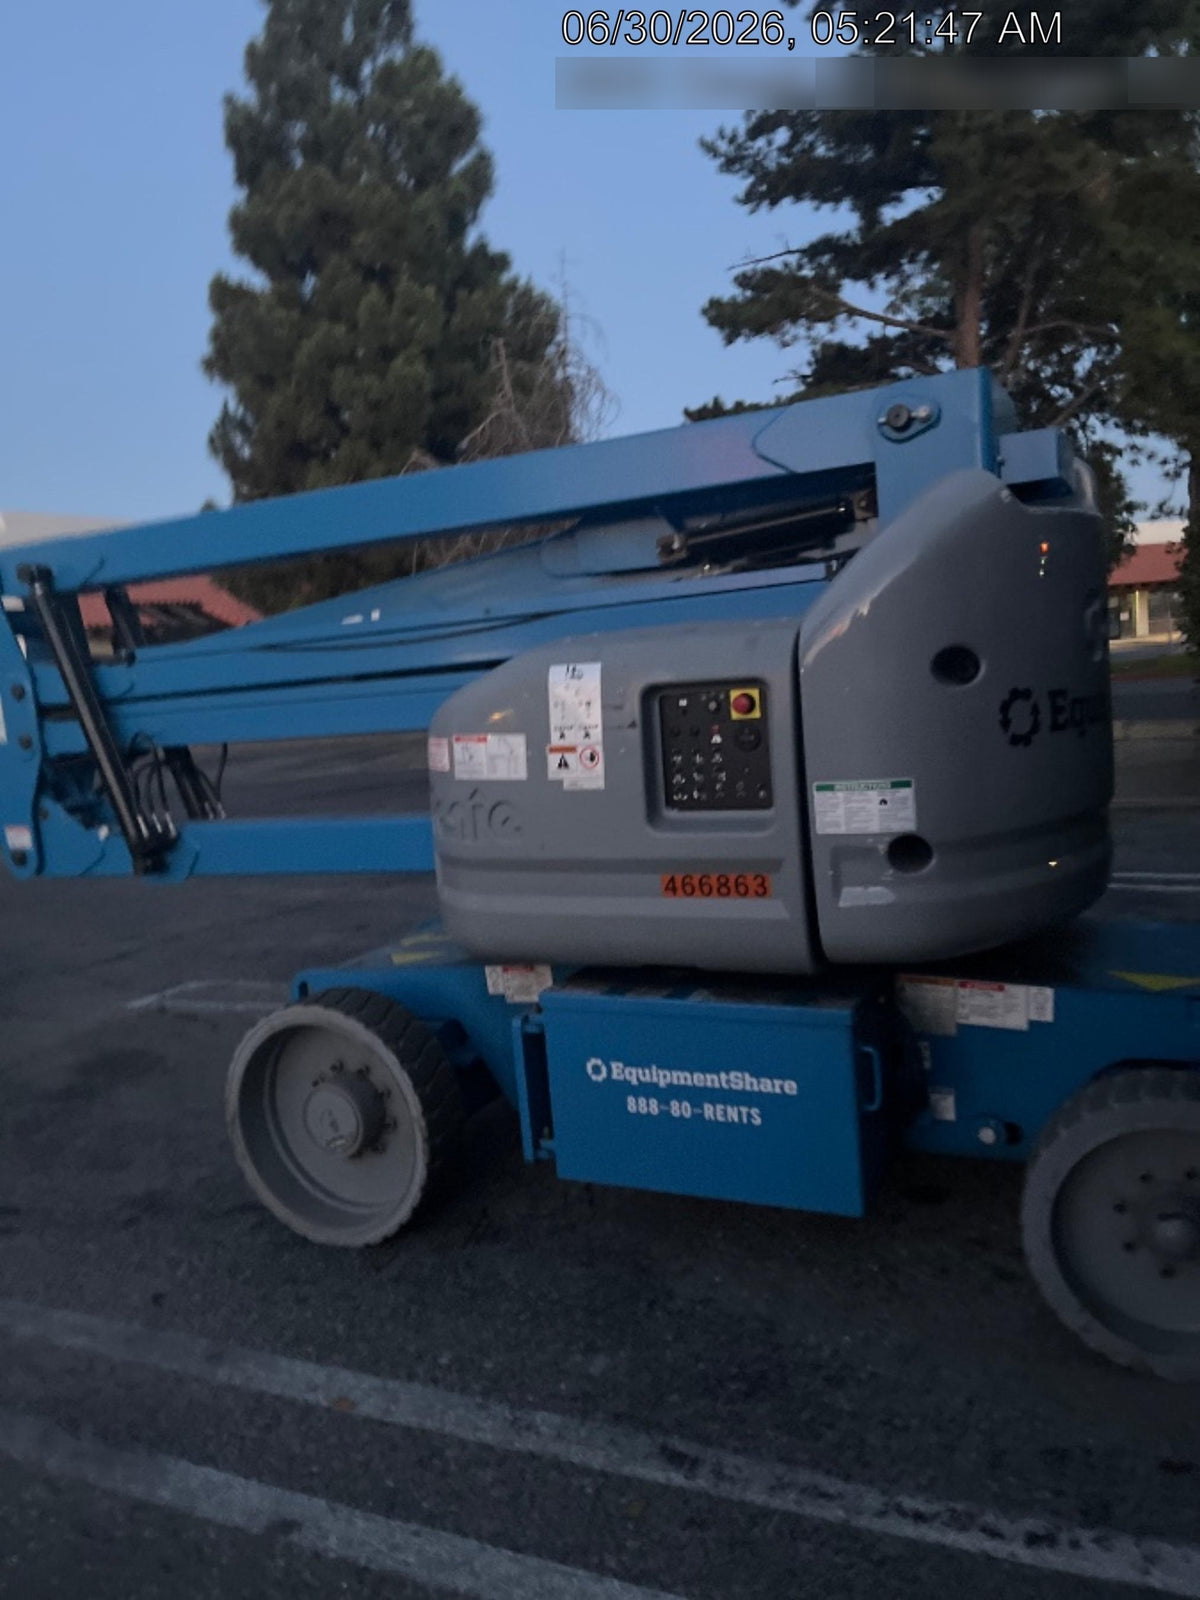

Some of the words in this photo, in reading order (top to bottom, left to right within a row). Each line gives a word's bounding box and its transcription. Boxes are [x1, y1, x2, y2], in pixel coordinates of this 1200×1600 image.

[663, 873, 768, 897] 466863
[610, 1061, 798, 1096] EquipmentShare
[626, 1095, 762, 1126] 888-80-RENTS
